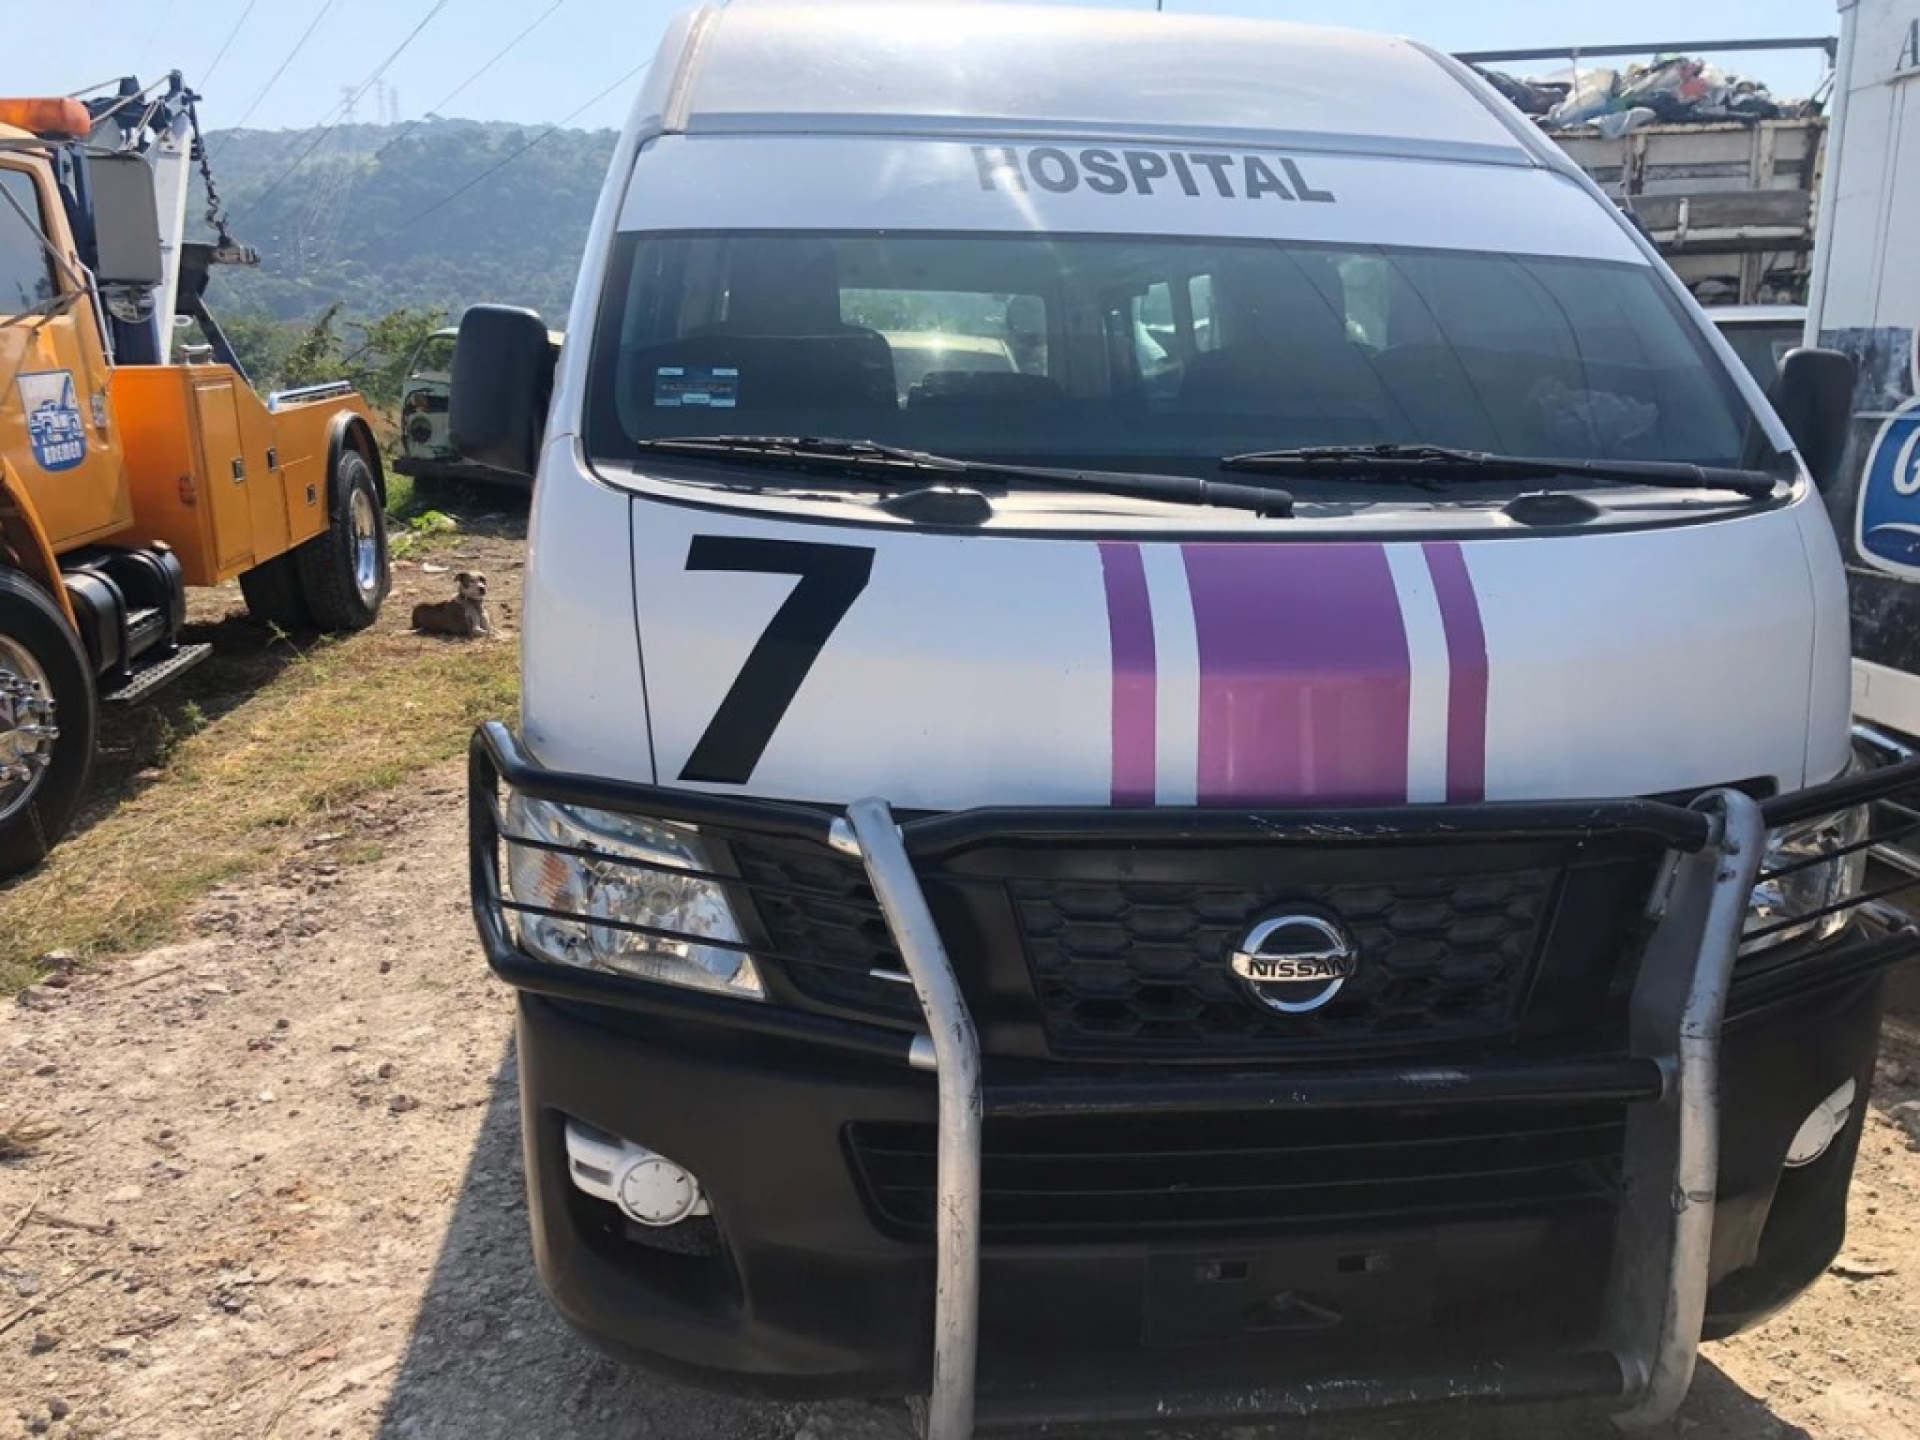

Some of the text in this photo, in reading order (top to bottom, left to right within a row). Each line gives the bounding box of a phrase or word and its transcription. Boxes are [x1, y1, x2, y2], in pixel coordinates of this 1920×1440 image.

[970, 146, 1337, 203] HOSPITAL
[677, 533, 876, 785] 7
[1249, 955, 1349, 976] NISSAN
